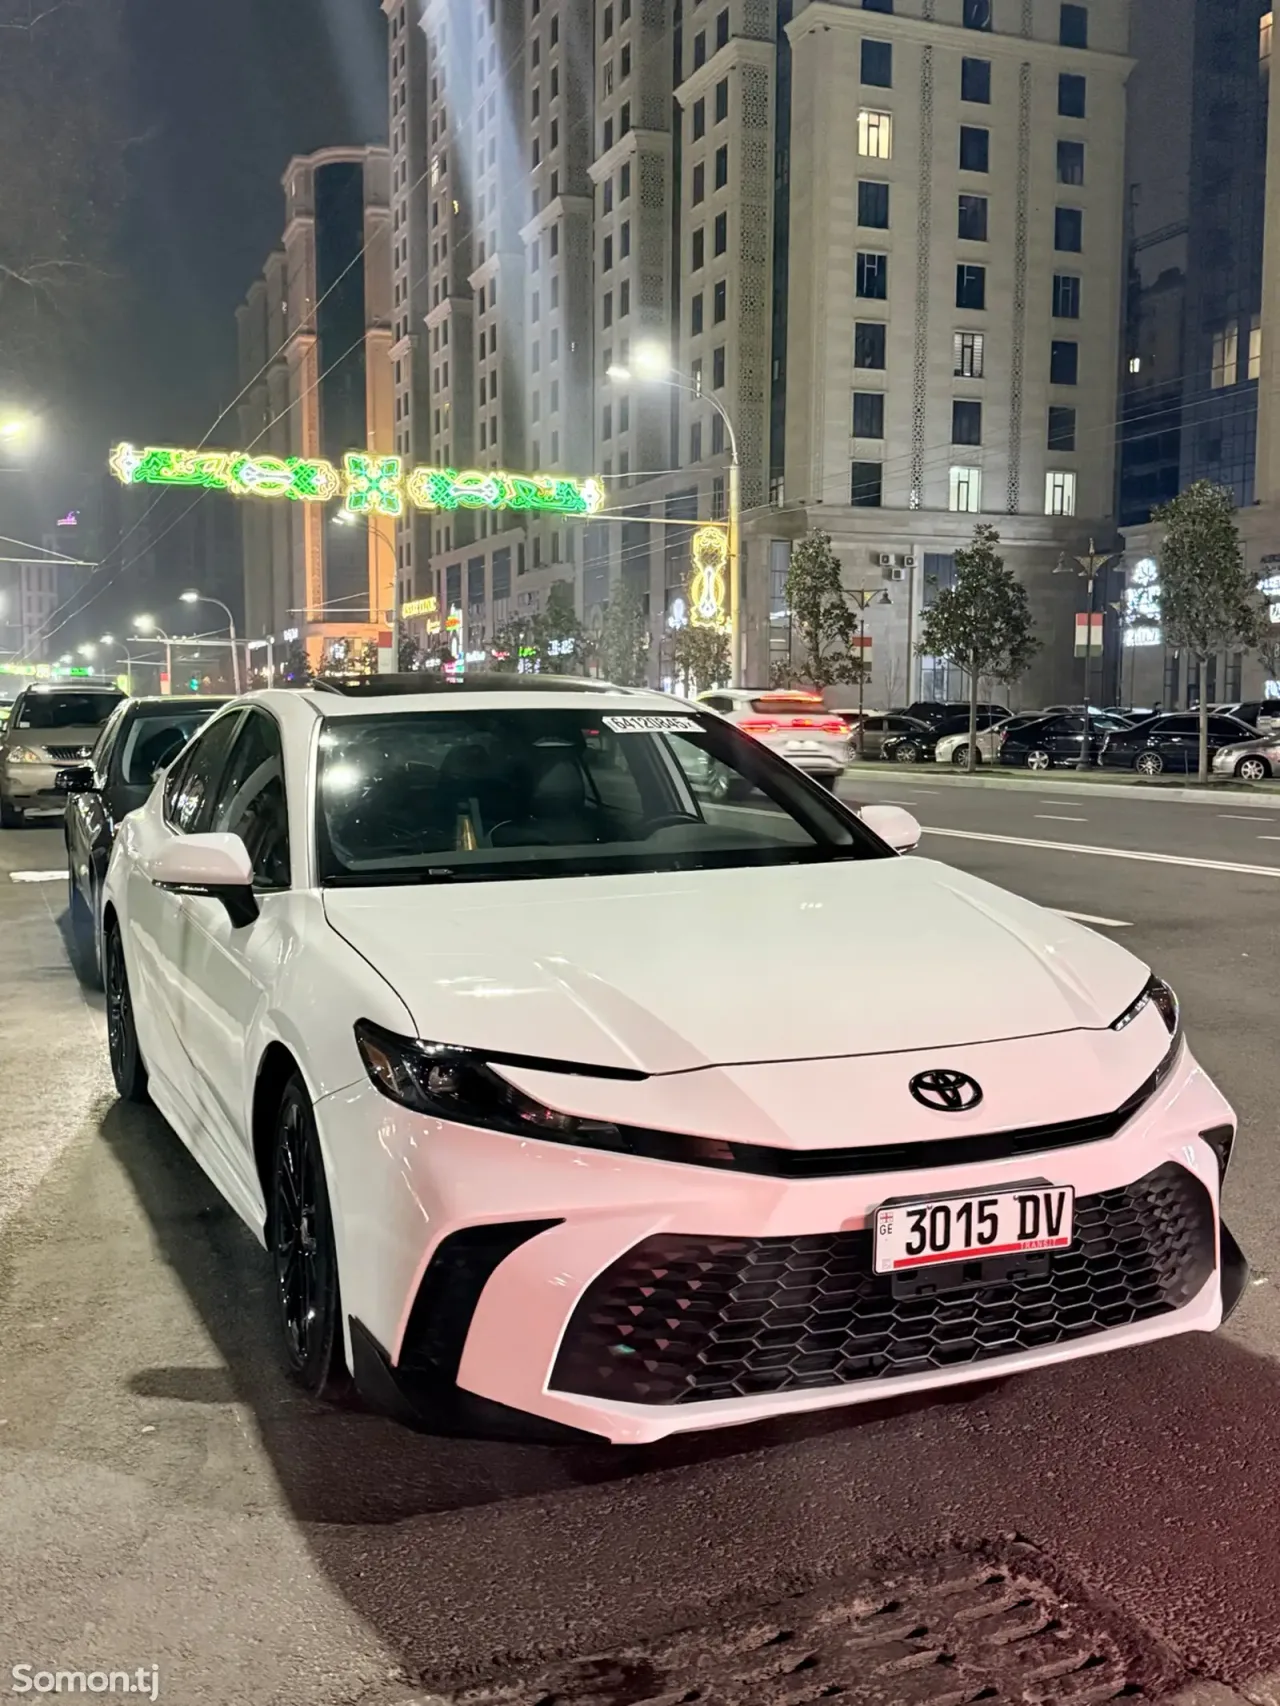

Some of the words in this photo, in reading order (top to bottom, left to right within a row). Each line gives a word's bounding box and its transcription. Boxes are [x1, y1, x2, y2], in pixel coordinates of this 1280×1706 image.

[906, 1198, 998, 1255] 3015
[1016, 1192, 1066, 1241] DV
[880, 1224, 893, 1235] GE
[1020, 1239, 1056, 1250] TRANSIT
